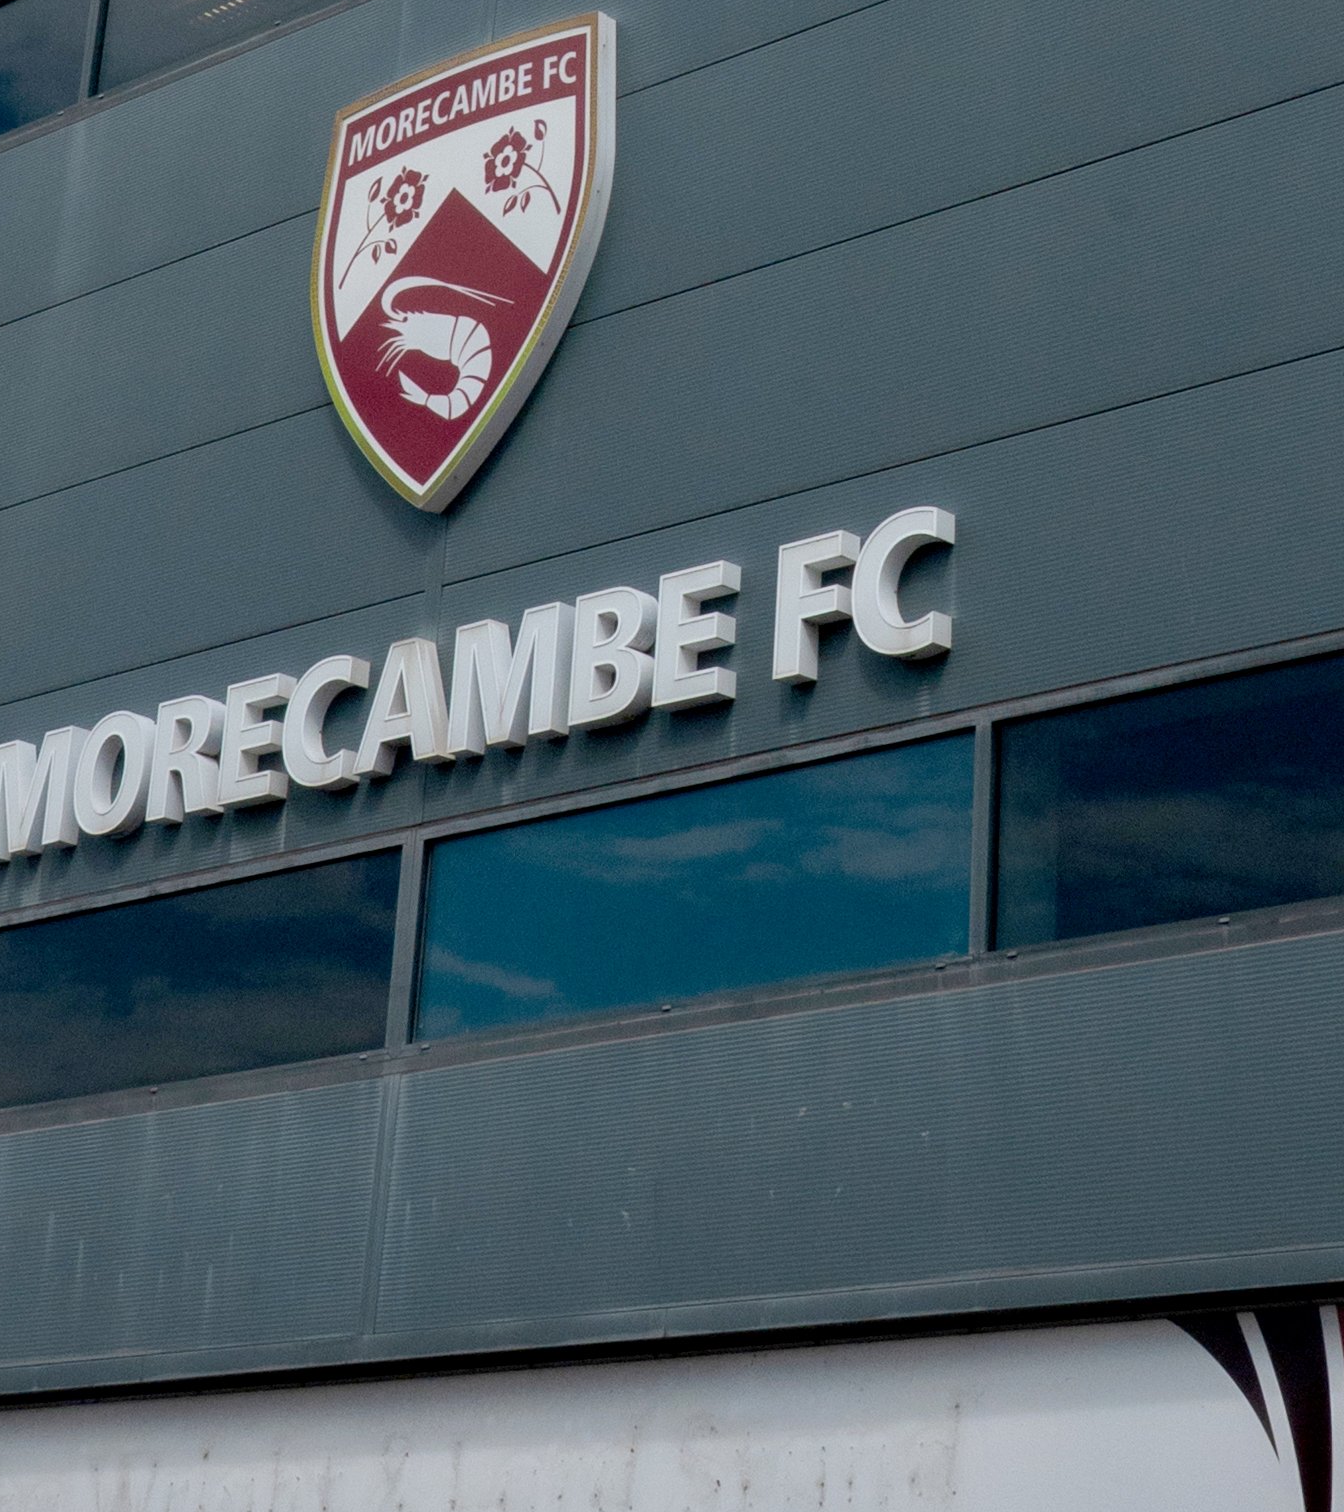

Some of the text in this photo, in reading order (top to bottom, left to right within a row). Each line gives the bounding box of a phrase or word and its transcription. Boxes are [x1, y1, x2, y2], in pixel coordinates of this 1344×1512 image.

[347, 50, 578, 167] MORECAMBE FC
[771, 505, 956, 687] FC
